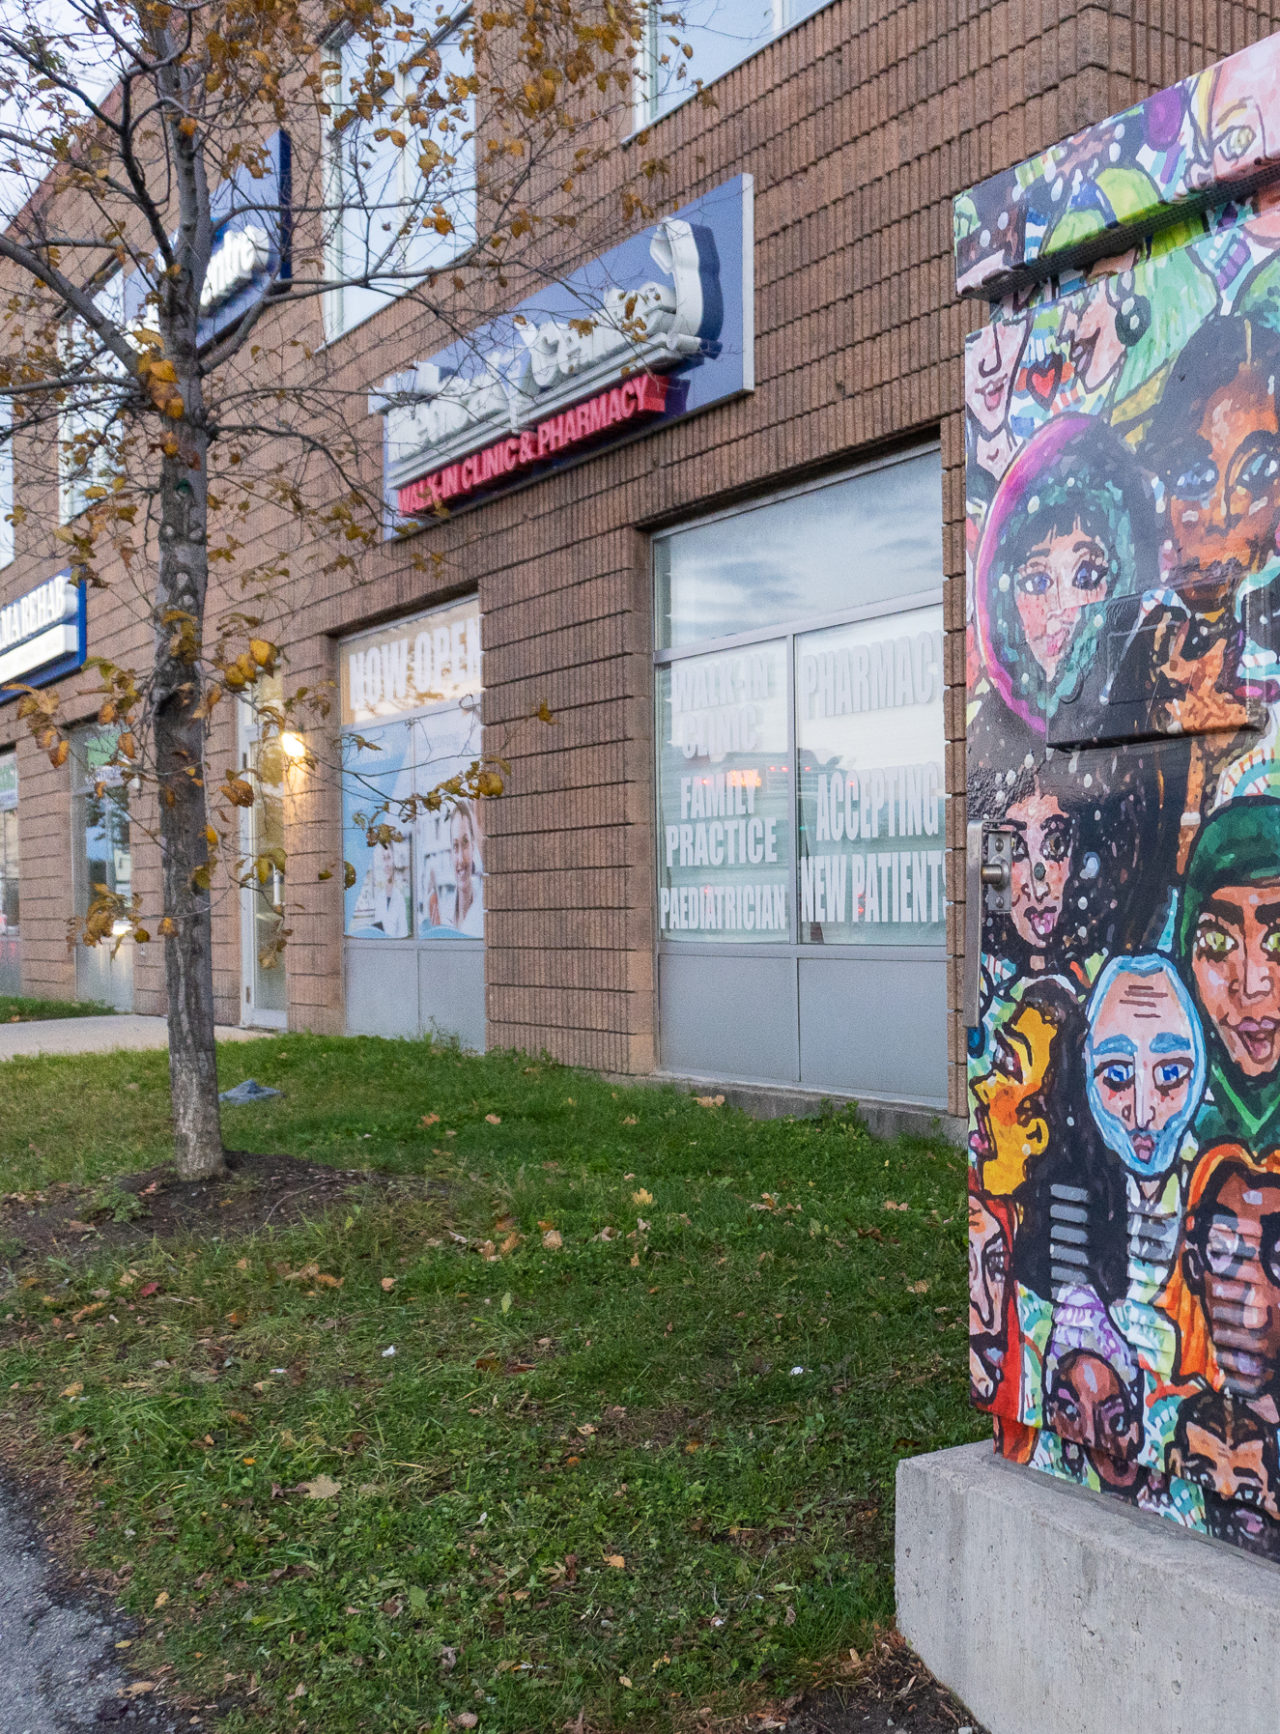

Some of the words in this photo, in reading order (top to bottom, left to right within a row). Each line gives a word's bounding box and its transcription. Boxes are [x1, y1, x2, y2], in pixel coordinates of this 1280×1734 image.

[462, 438, 520, 488] CLINIC
[519, 431, 534, 463] &
[538, 373, 651, 456] PHARMACY
[21, 575, 67, 638] REHAB
[350, 638, 408, 710] NOW
[671, 652, 771, 713] WALK-IN
[682, 703, 760, 761] CLINIC
[680, 769, 762, 820] FAMILY
[816, 761, 940, 842] ACCEPTING
[665, 816, 778, 868] PRACTICE
[660, 884, 786, 930] PAEDIATRICIAN
[801, 854, 848, 923] NEW
